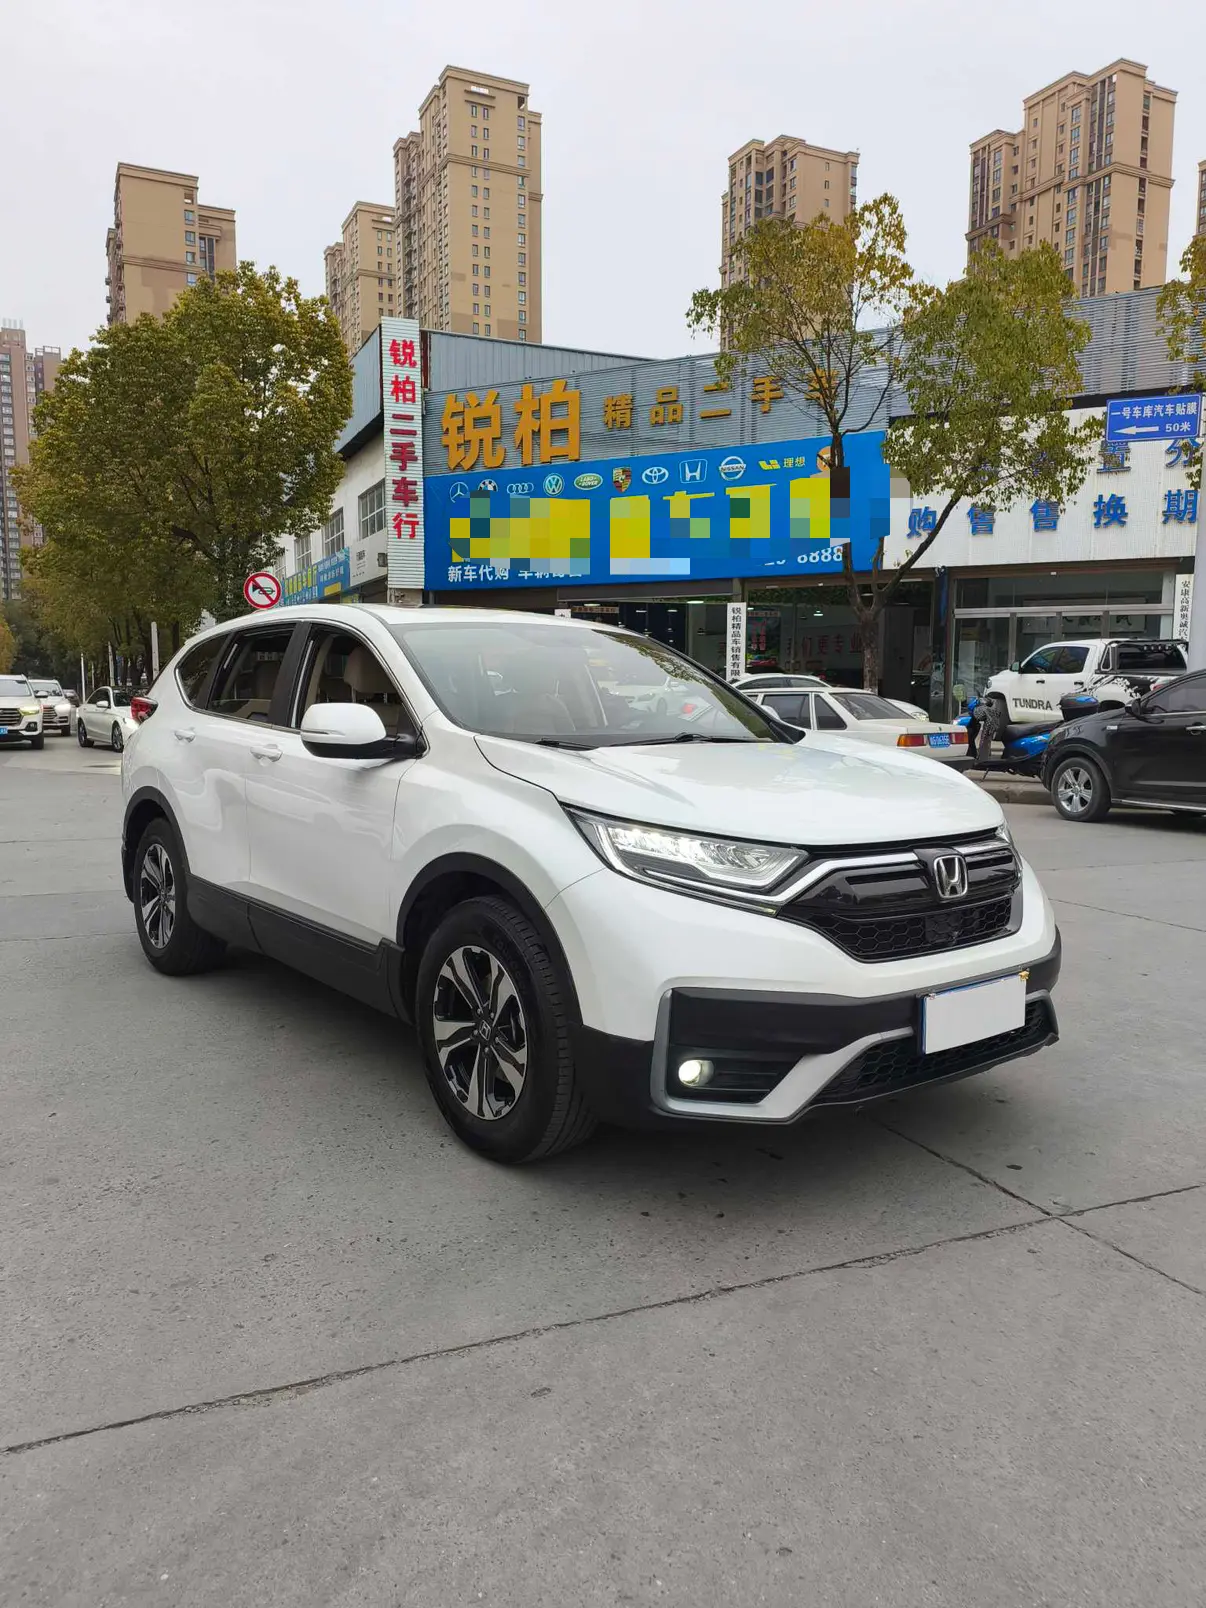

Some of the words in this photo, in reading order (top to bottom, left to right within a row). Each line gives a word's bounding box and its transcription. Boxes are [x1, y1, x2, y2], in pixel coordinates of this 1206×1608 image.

[1111, 402, 1198, 419] 一号车库汽车贴膜
[441, 379, 582, 471] 锐柏
[1165, 422, 1191, 432] 50米
[389, 339, 419, 539] 锐柏二手车行
[721, 464, 746, 472] NISSAN
[448, 565, 509, 582] 新车代购
[1012, 697, 1053, 711] TUNDRA
